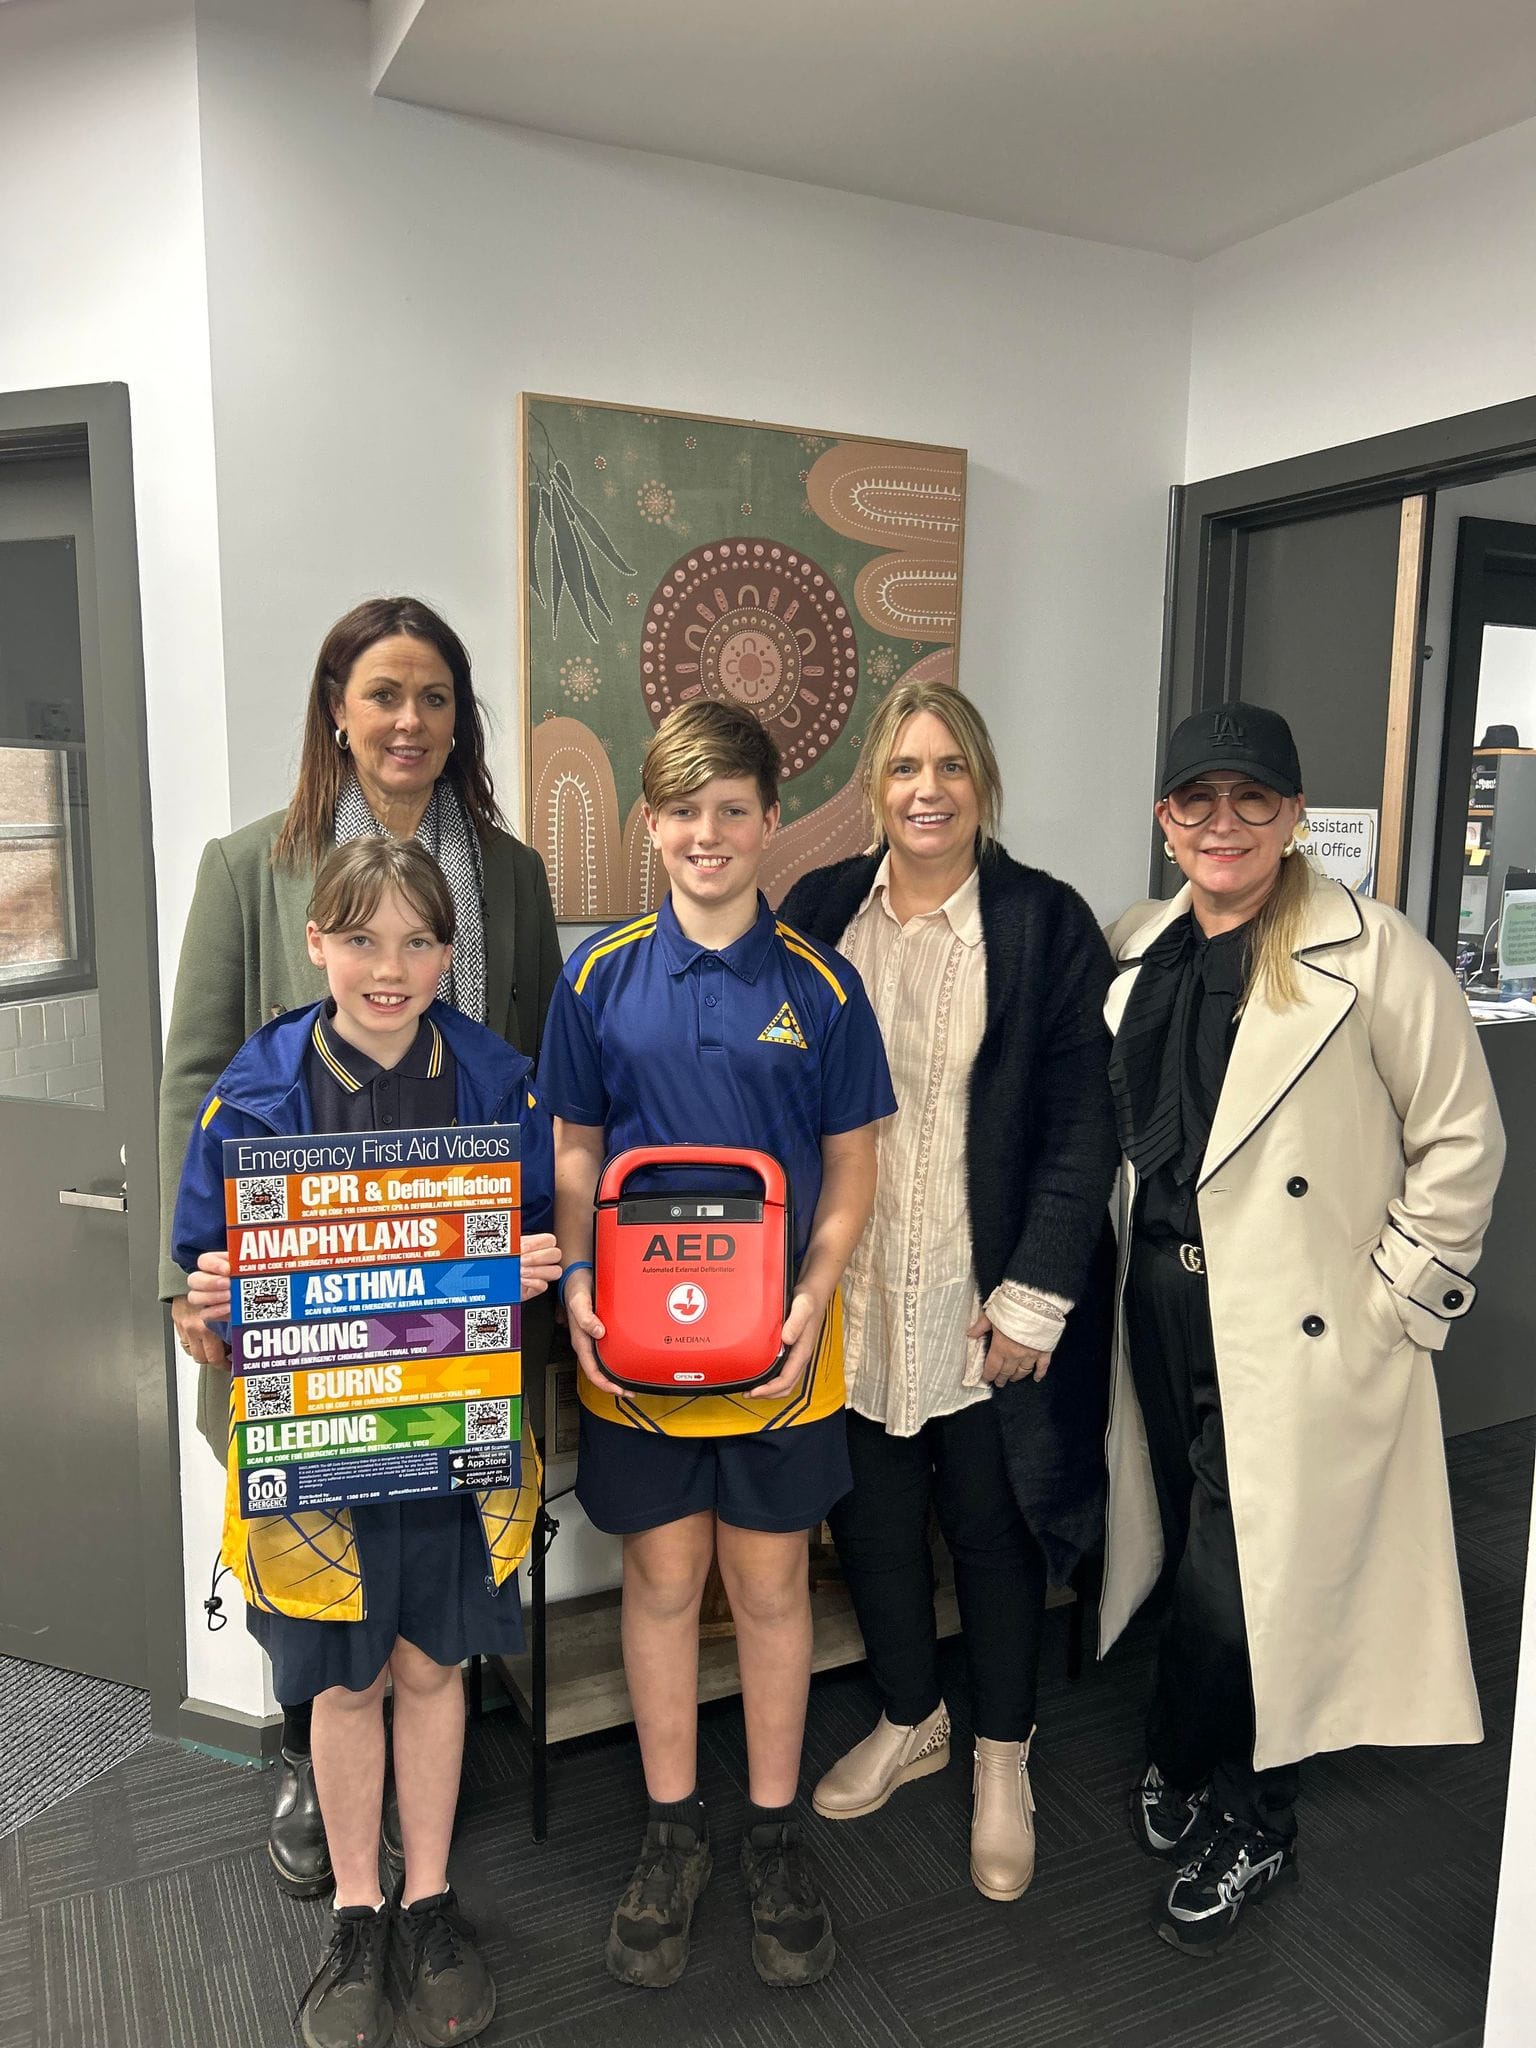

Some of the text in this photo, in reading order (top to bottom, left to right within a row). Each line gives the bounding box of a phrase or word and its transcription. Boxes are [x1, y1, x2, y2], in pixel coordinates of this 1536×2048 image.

[1303, 819, 1364, 834] Assistant
[1321, 843, 1362, 858] Office
[238, 1134, 510, 1173] Emergency First Aid Videos
[301, 1174, 512, 1206] CPR & Defibrillation
[328, 1208, 343, 1216] CODE
[356, 1205, 390, 1214] EMERGENCY
[497, 1197, 512, 1205] VIDEO
[239, 1218, 438, 1261] ANAPHYLAXIS
[642, 1233, 736, 1261] AED
[238, 1264, 256, 1272] SCAN
[267, 1262, 284, 1270] CODE
[298, 1258, 334, 1267] EMERGENCY
[334, 1255, 376, 1265] ANAPHYLAXIS
[424, 1250, 440, 1258] VIDEO
[304, 1268, 425, 1305] ASTHMA
[304, 1308, 322, 1316] SCAN
[332, 1306, 348, 1314] CODE
[362, 1302, 396, 1311] EMERGENCY
[398, 1300, 423, 1308] ASTHMA
[424, 1296, 468, 1306] INSTRUCTIONAL
[470, 1295, 486, 1303] VIDEO
[242, 1320, 368, 1359] CHOKING
[674, 1336, 711, 1344] MEDIANA
[242, 1346, 428, 1370] SCAN QR CODE FOR EMERGENCY CHOKING INSTRUCTIONAL VIDEO
[307, 1365, 403, 1401] BURNS
[308, 1403, 325, 1411] SCAN
[334, 1400, 350, 1408] CODE
[364, 1396, 398, 1406] EMERGENCY
[465, 1388, 482, 1396] VIDEO
[246, 1414, 377, 1455] BLEEDING
[246, 1457, 264, 1465] SCAN
[274, 1454, 290, 1462] CODE
[290, 1453, 303, 1461] FOR
[304, 1449, 338, 1459] EMERGENCY
[339, 1446, 367, 1456] BLEEDING
[368, 1441, 412, 1453] INSTRUCTIONAL
[412, 1440, 430, 1448] VIDEO
[467, 1457, 507, 1468] App Store
[247, 1481, 287, 1500] 000
[466, 1474, 511, 1485] Google play
[248, 1499, 287, 1510] EMERGENCY
[310, 1496, 343, 1504] HEALTHCARE
